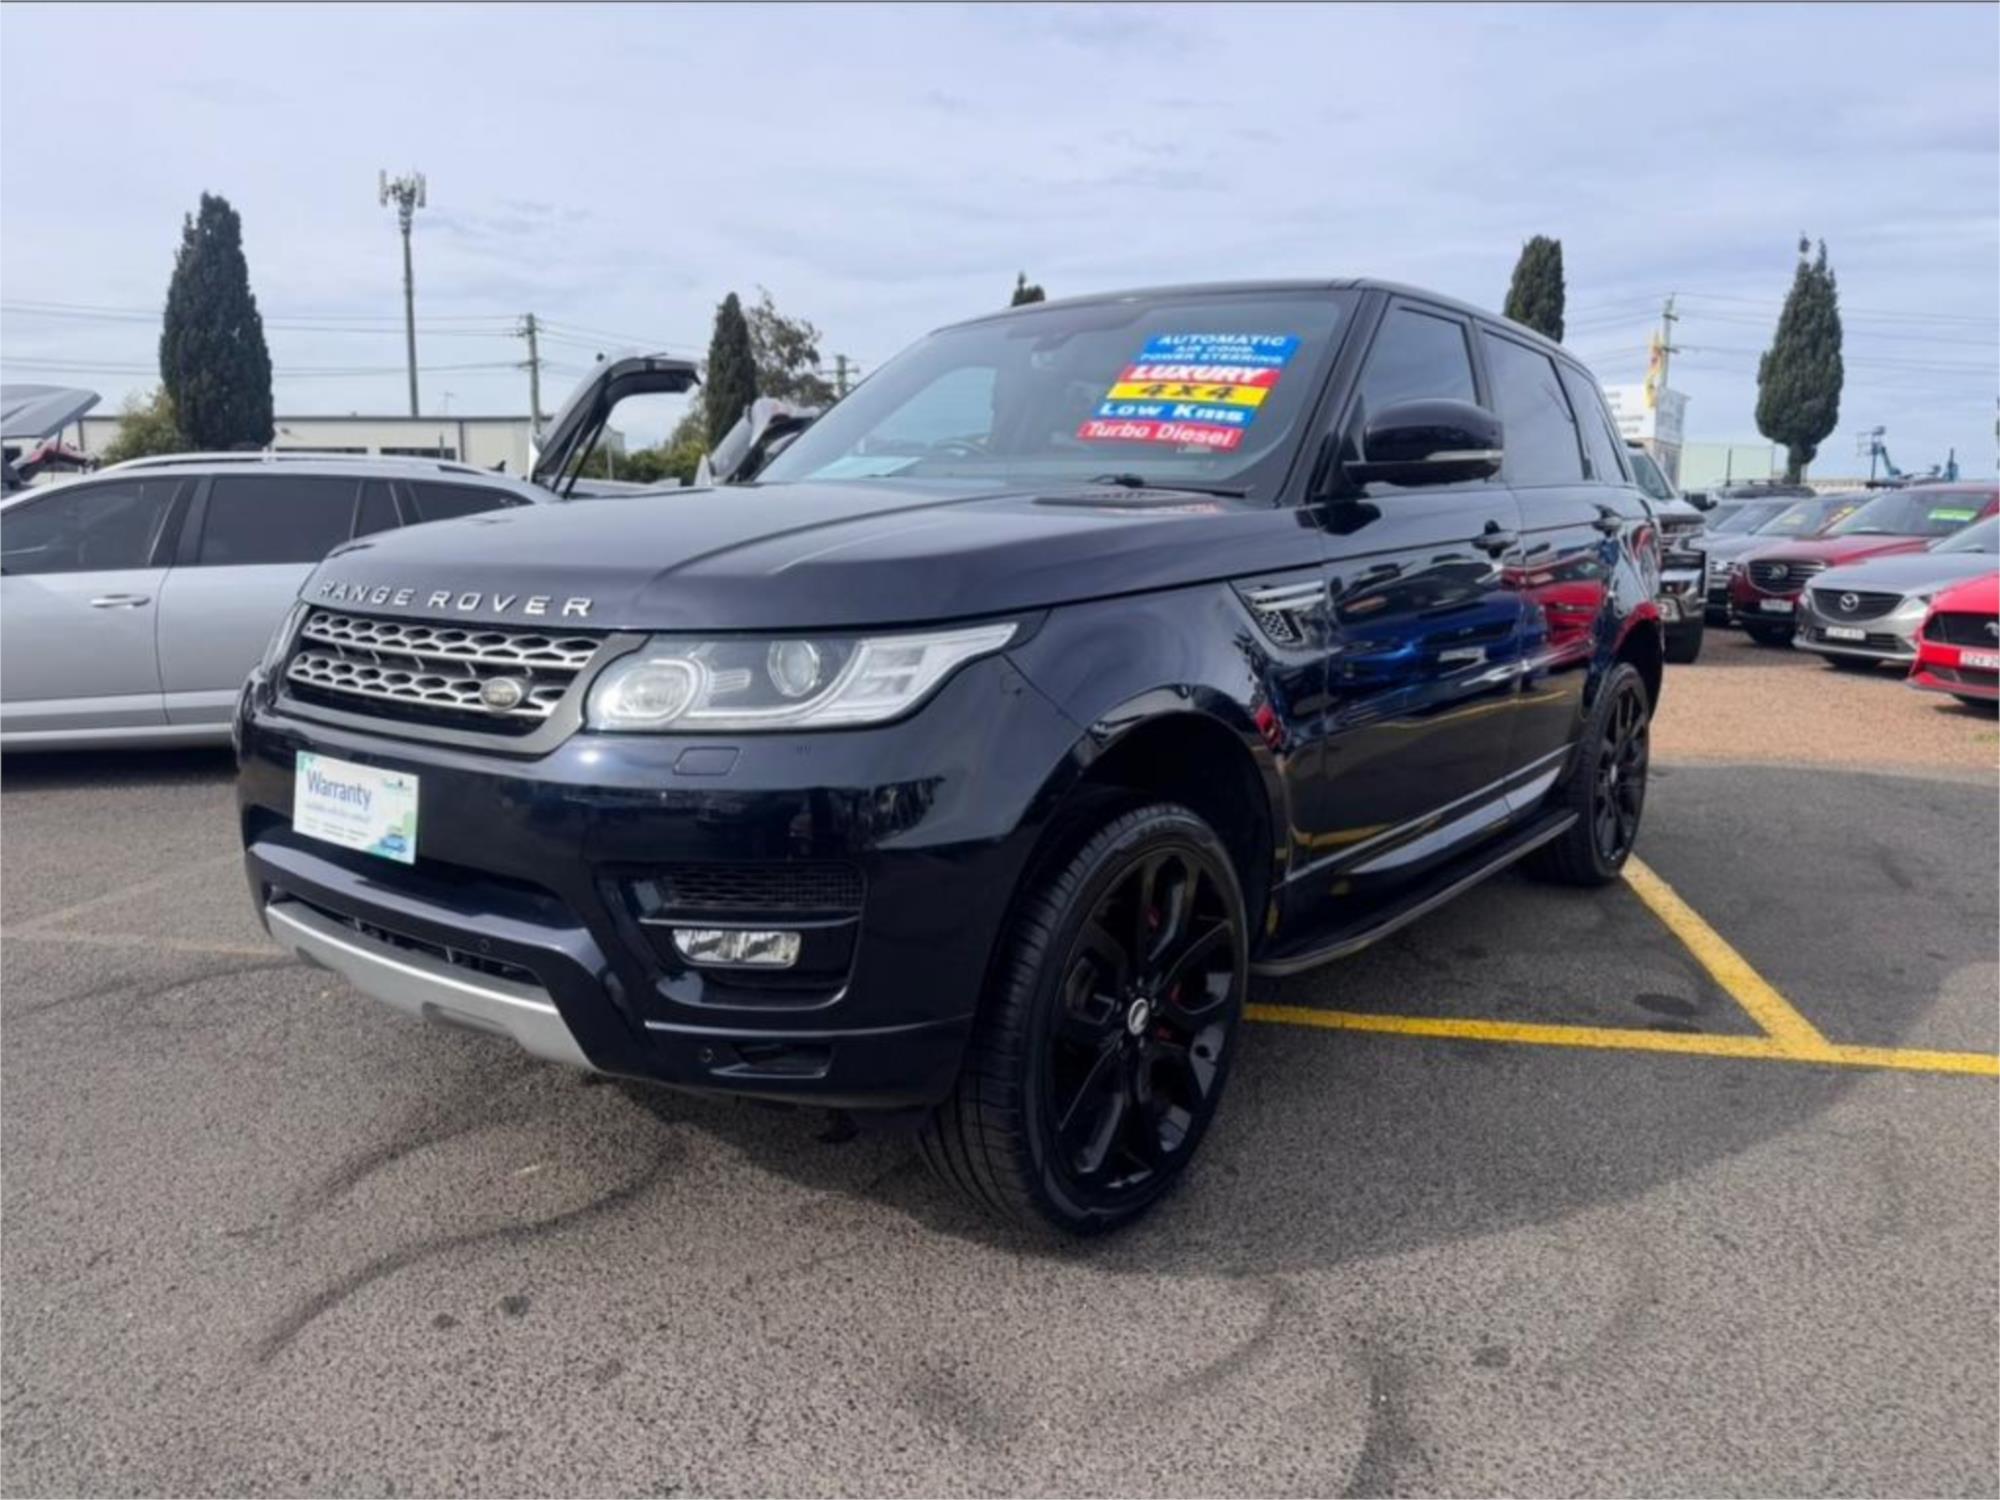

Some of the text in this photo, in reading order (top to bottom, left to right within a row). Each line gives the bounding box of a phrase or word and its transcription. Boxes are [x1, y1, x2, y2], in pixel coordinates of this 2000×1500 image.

[1157, 334, 1286, 346] AUTOMATIC
[1130, 364, 1264, 383] LUXURY
[1100, 403, 1245, 422] Low Kms
[1087, 422, 1232, 446] Turbo Diesel
[319, 580, 592, 617] RANGE ROVER
[307, 769, 373, 812] Warranty
